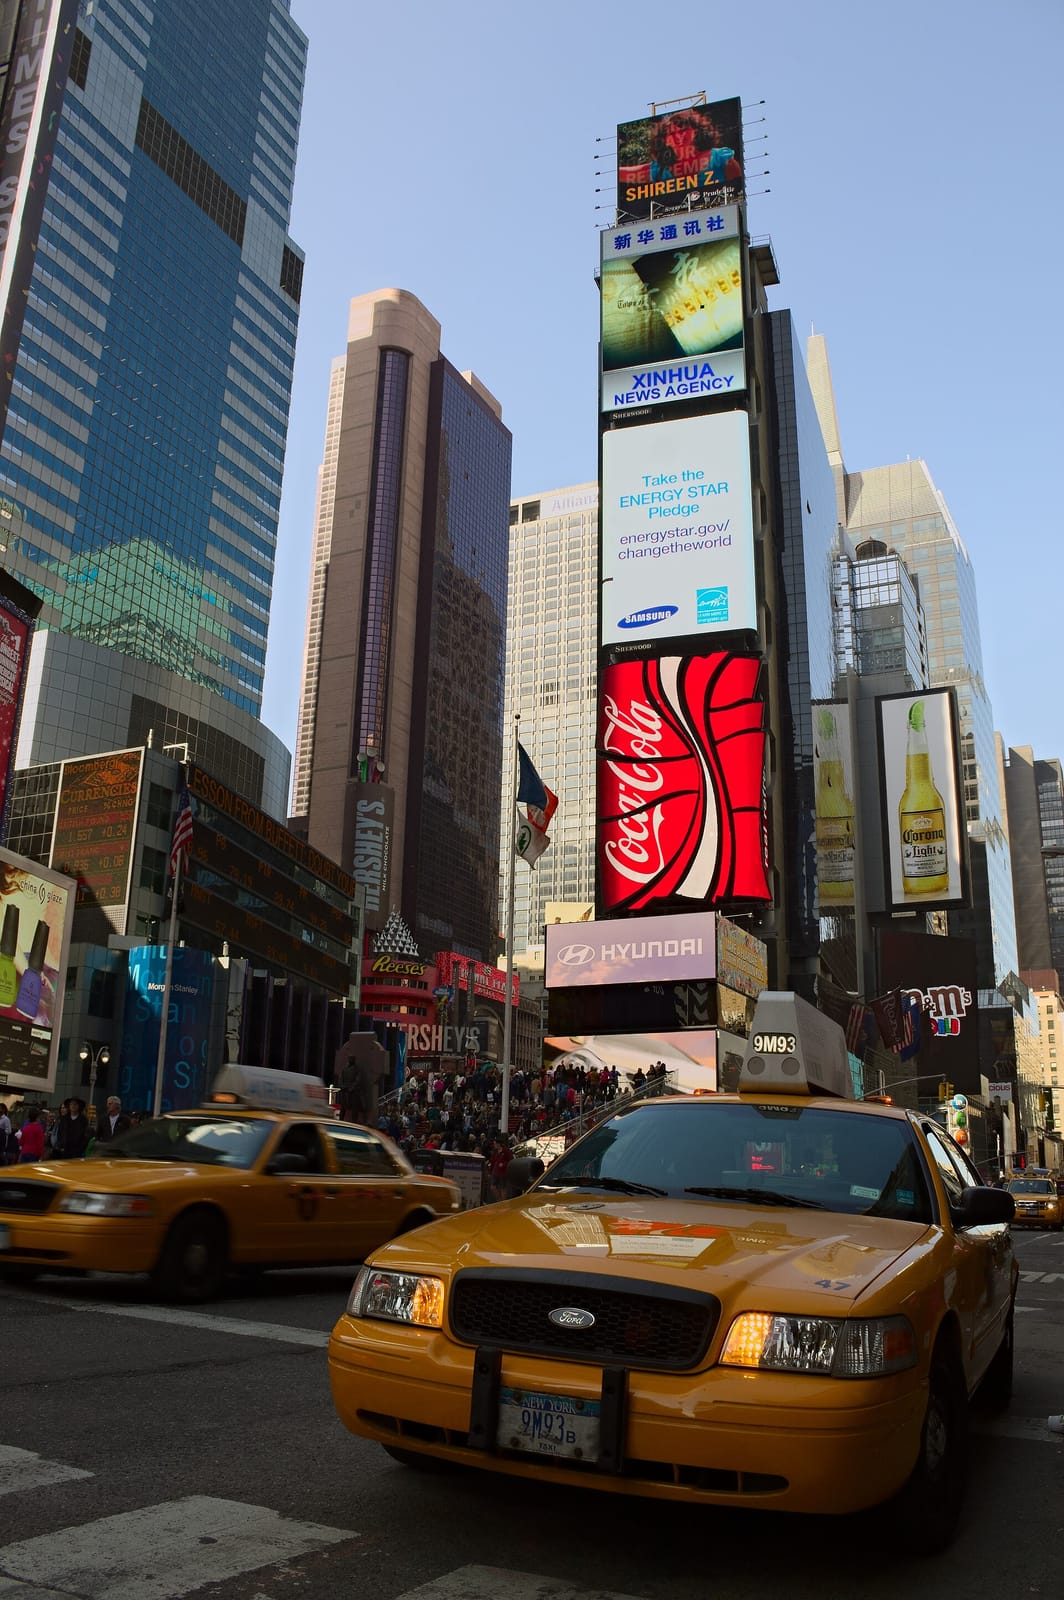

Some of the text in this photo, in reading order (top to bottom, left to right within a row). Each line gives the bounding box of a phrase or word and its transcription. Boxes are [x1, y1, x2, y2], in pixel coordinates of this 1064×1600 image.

[625, 171, 719, 202] SHIREEN Z.
[614, 215, 725, 250] 新华通讯社
[632, 363, 715, 390] XINHUA
[614, 375, 735, 406] NEWS AGENCY
[642, 469, 705, 487] Take the
[619, 482, 729, 508] ENERGY STAR
[648, 503, 700, 519] Pledge
[620, 519, 730, 545] energystar.gov/
[618, 534, 732, 560] changetheworld
[625, 610, 671, 624] SAMSUNG
[605, 694, 665, 884] Coca-Cola
[903, 829, 944, 845] Corona
[912, 845, 937, 858] Light
[601, 938, 703, 961] HYUNDAI
[148, 982, 199, 996] Morgn Stanley
[753, 1035, 796, 1053] 9M93
[815, 1279, 851, 1291] 47
[559, 1311, 585, 1325] Ford
[522, 1396, 577, 1414] NEW YORK
